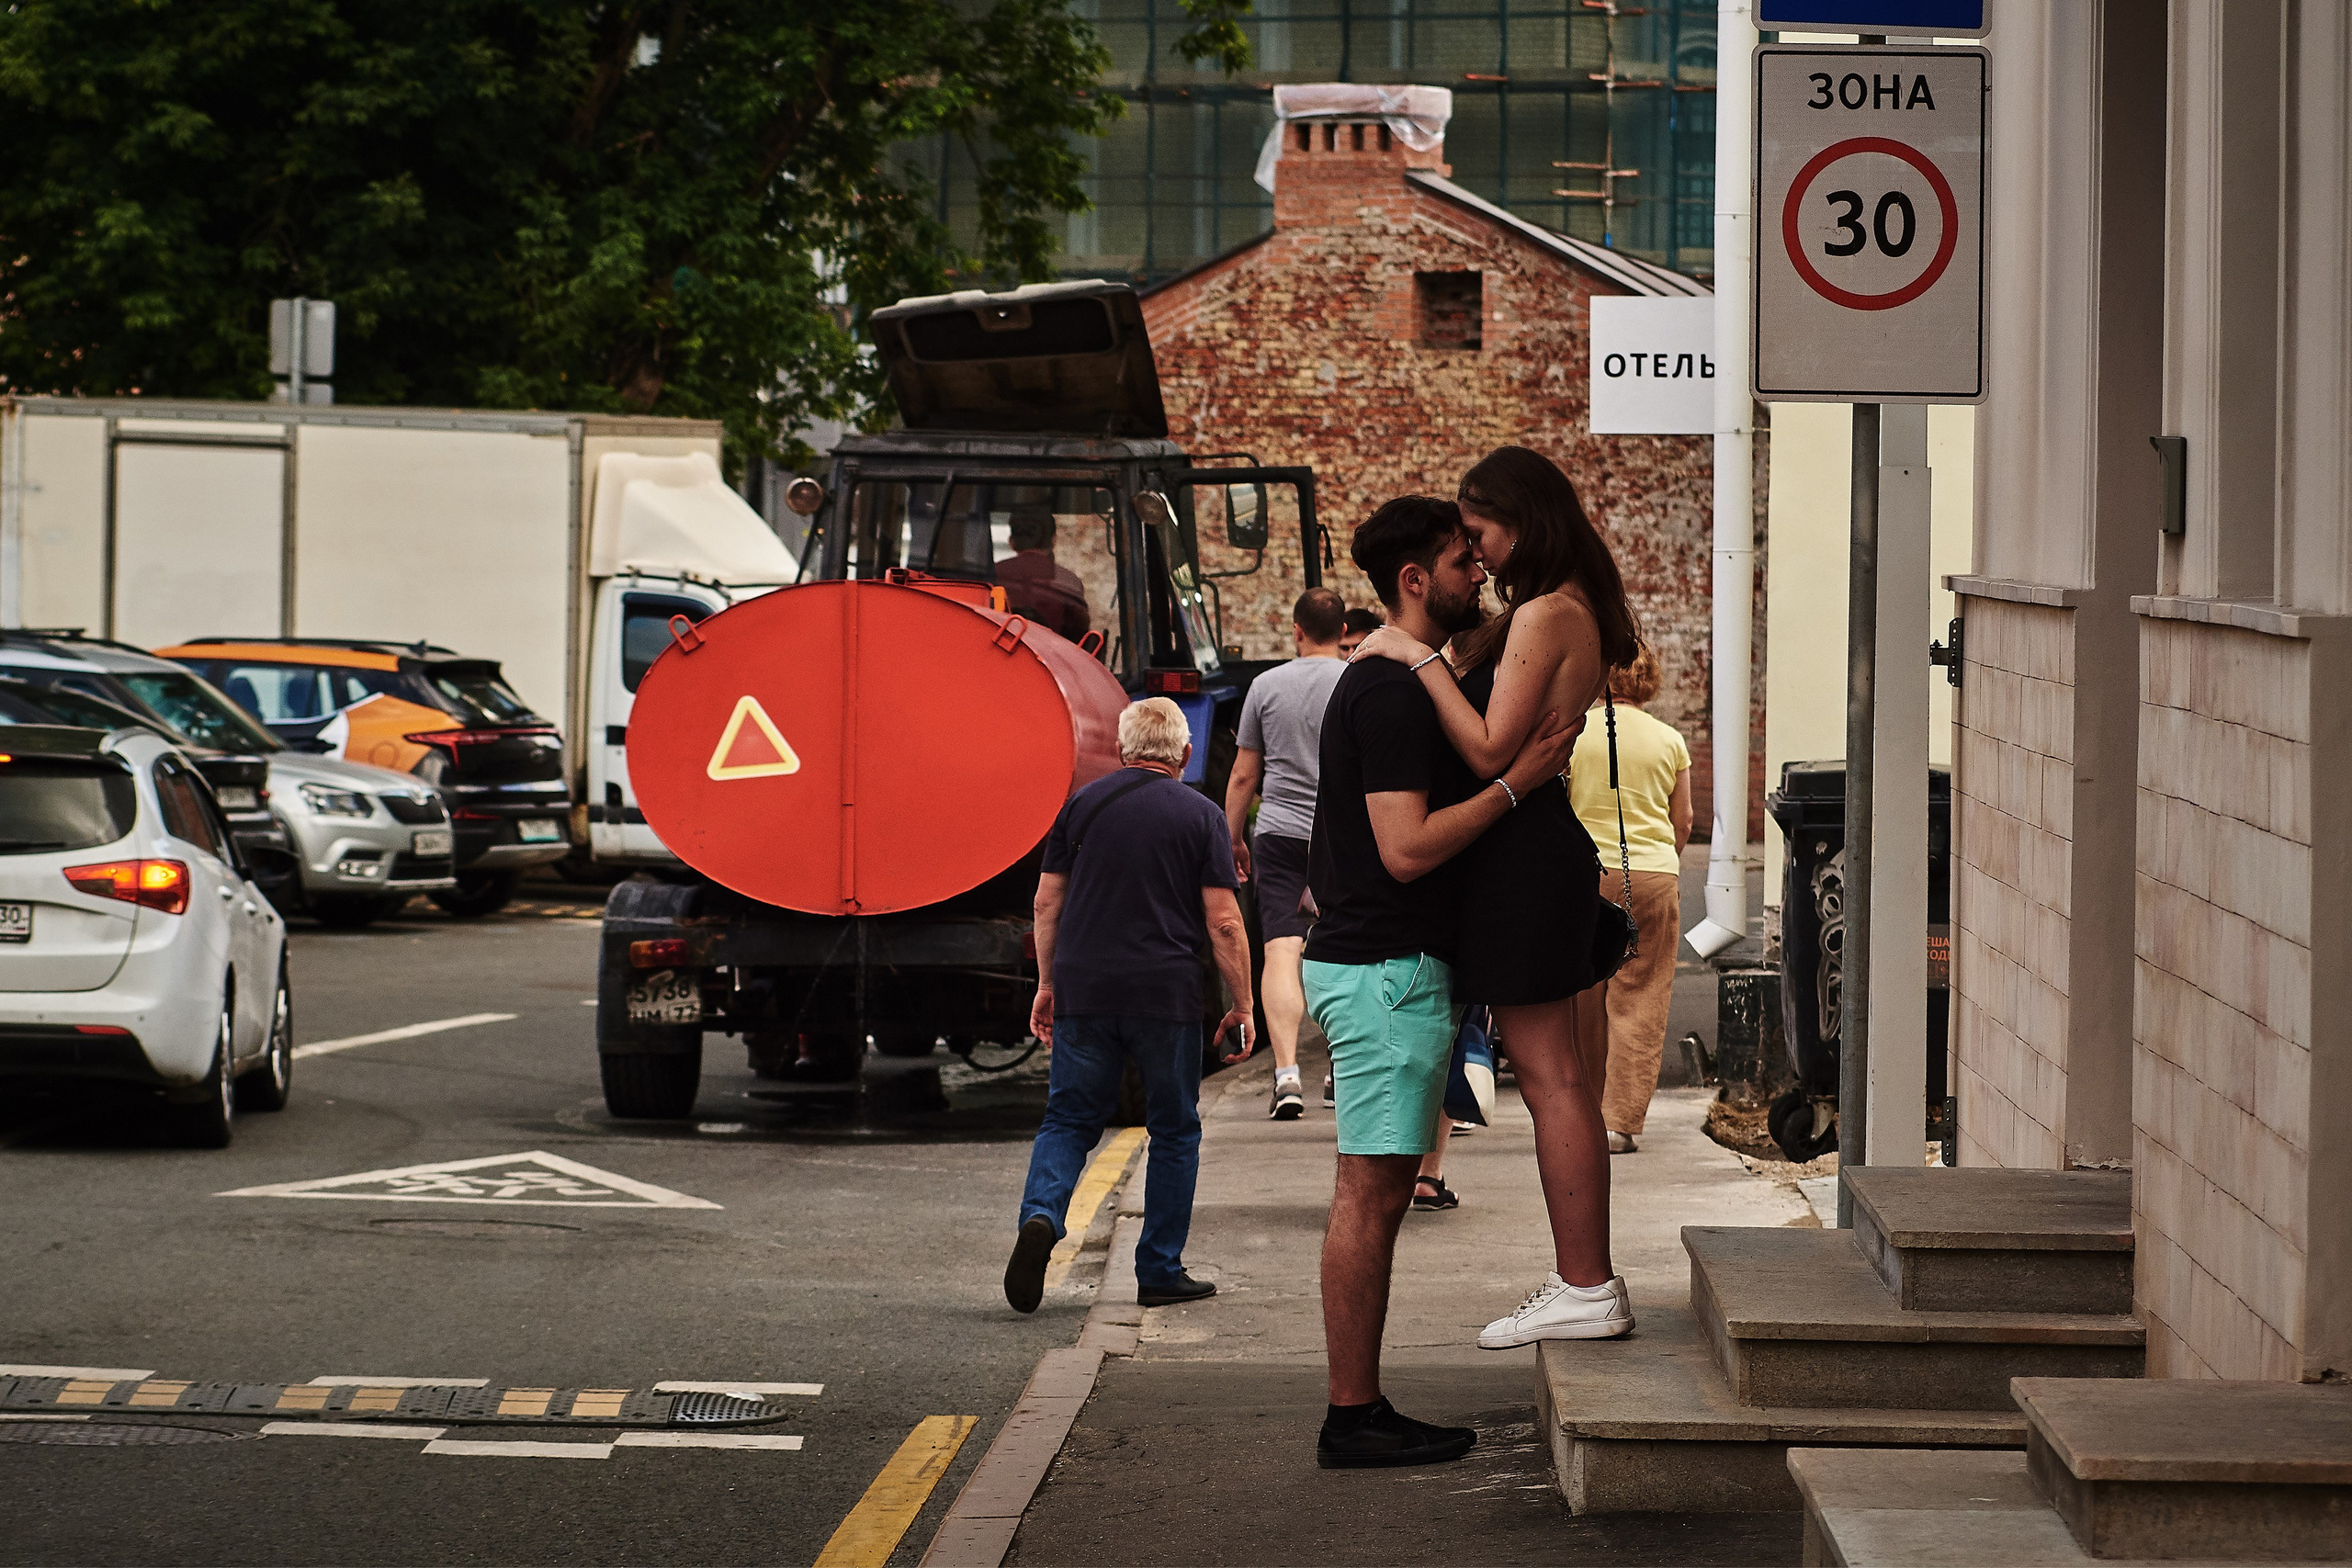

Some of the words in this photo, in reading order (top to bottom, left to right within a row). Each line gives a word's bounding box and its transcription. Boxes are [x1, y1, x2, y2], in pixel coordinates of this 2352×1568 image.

[1807, 72, 1936, 111] ЗОНА
[1823, 189, 1917, 258] 30
[1604, 353, 1715, 378] ОТЕЛЬ
